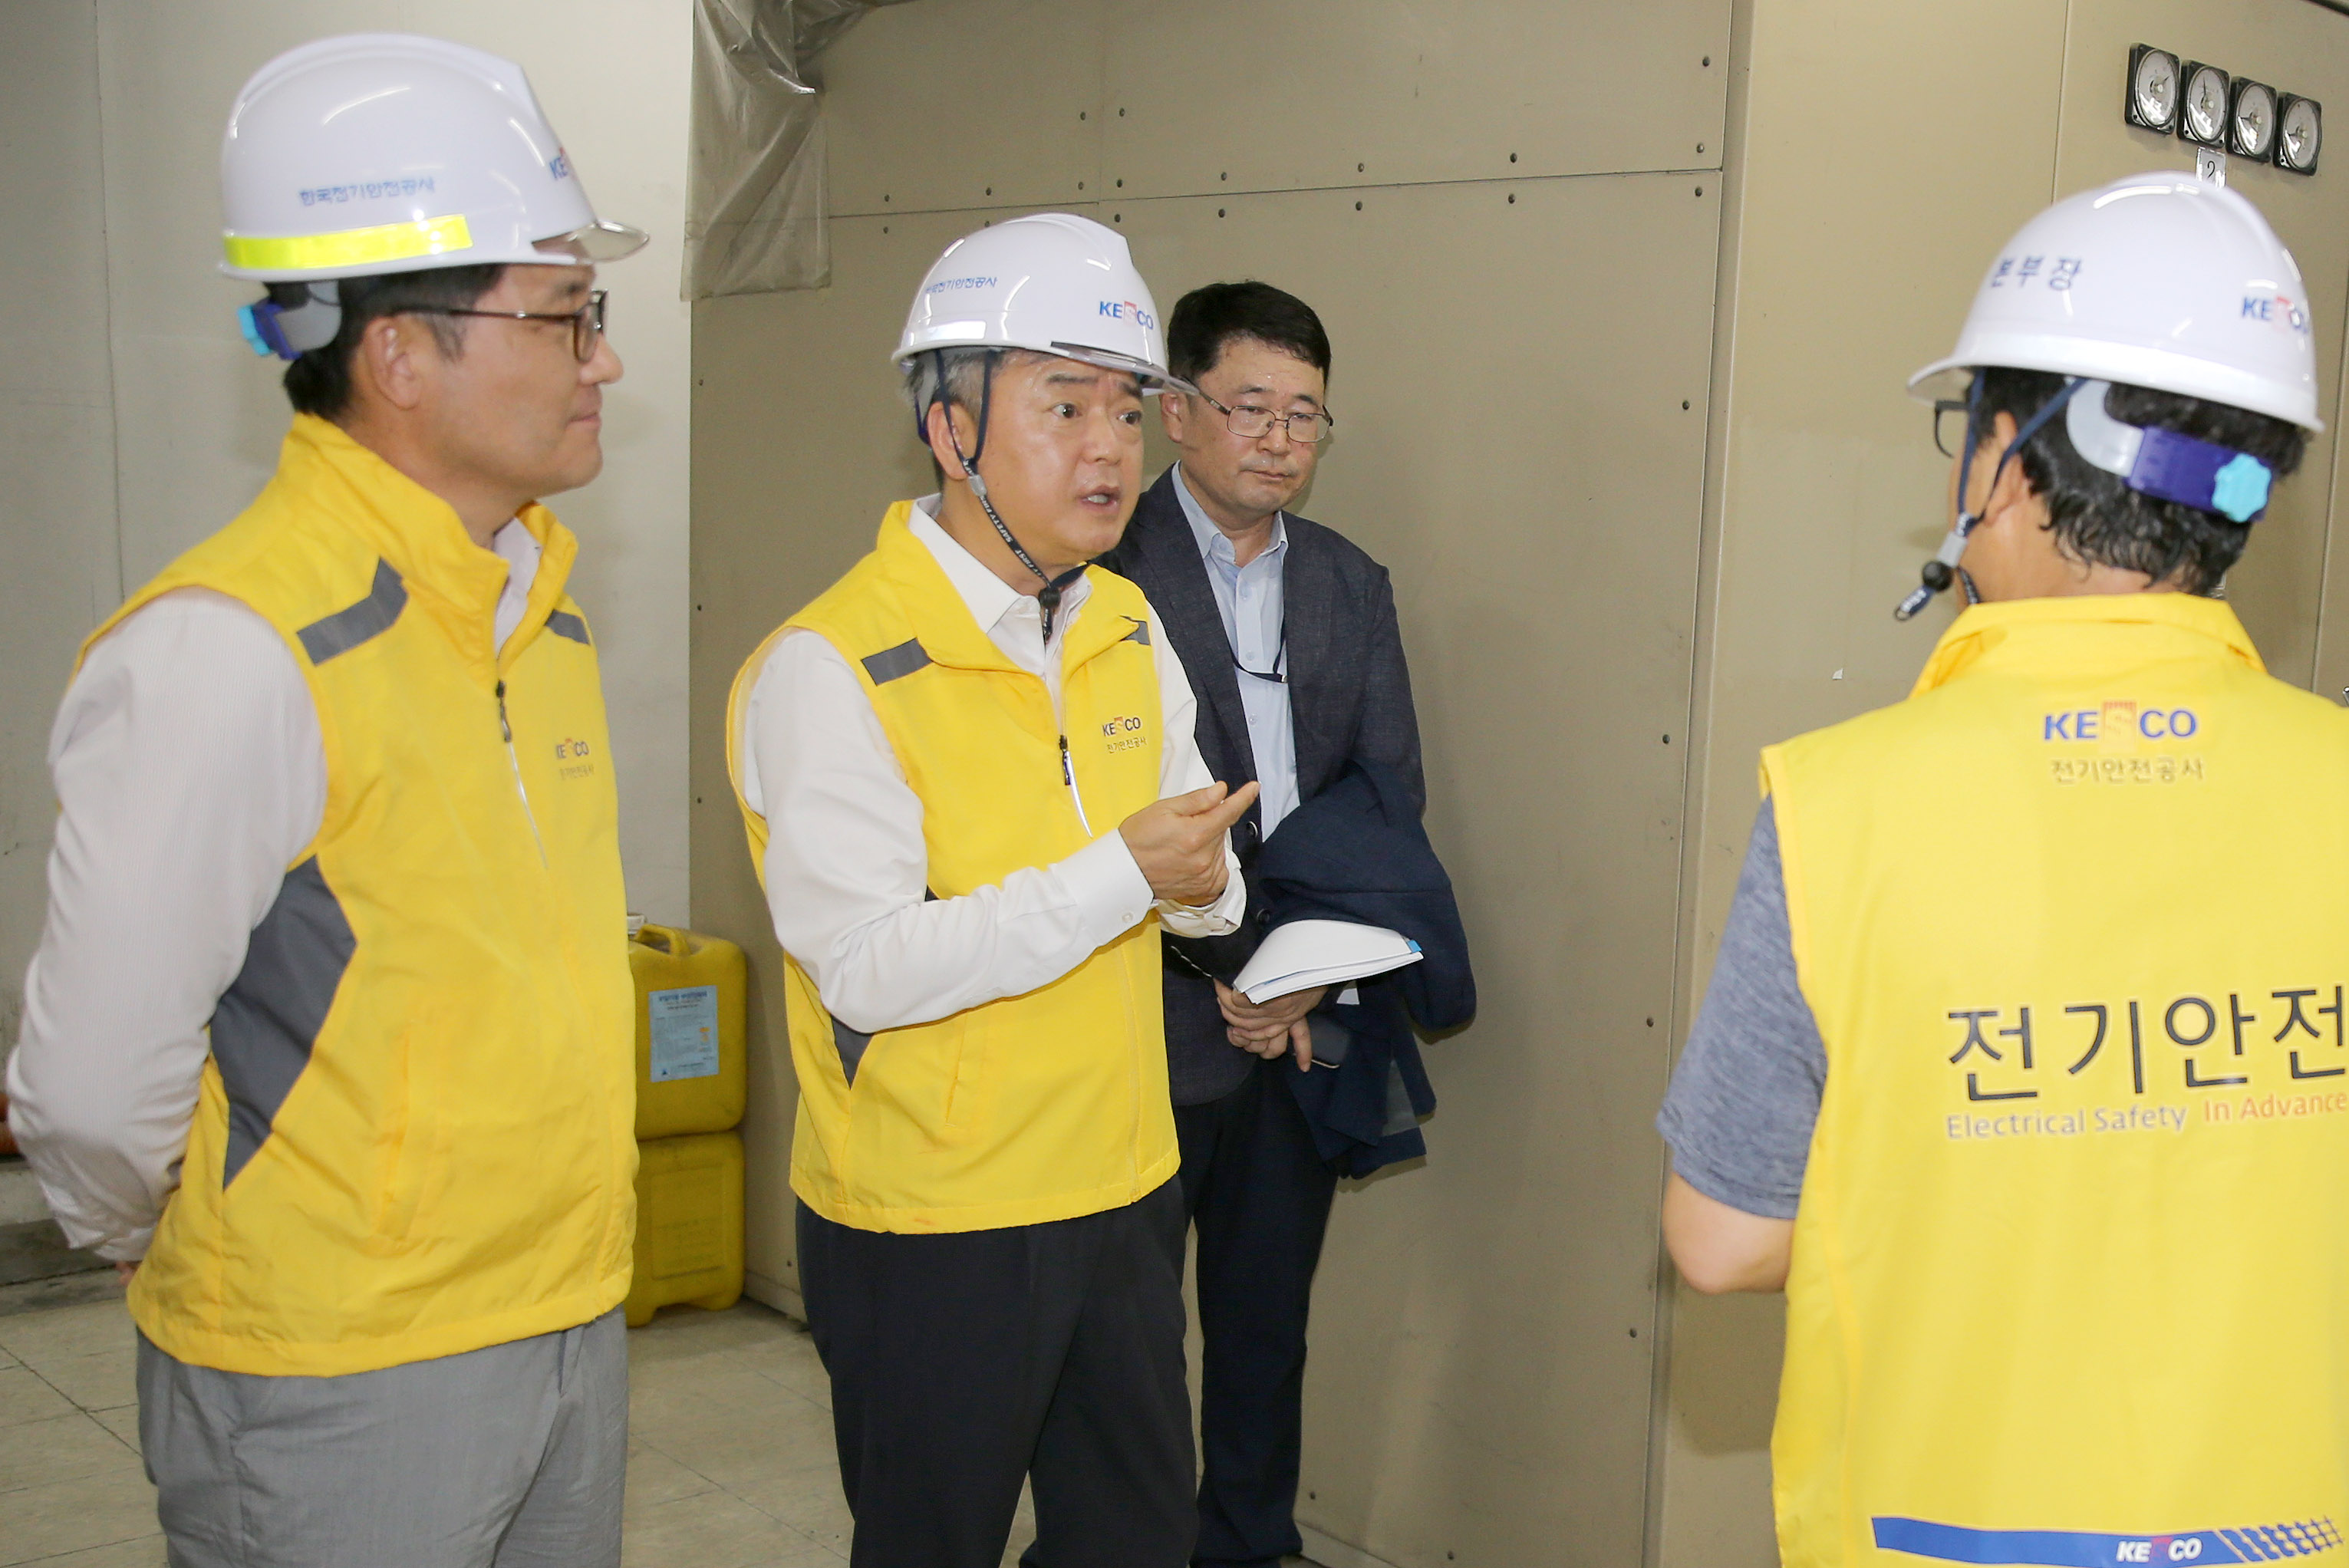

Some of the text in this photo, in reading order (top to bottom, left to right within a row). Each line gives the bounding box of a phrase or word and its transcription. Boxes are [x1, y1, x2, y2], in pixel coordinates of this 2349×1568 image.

[2051, 757, 2206, 785] 전기안전공사
[1947, 985, 2347, 1102] 전기안전
[1947, 1092, 2349, 1140] Electrical Safety In Advance
